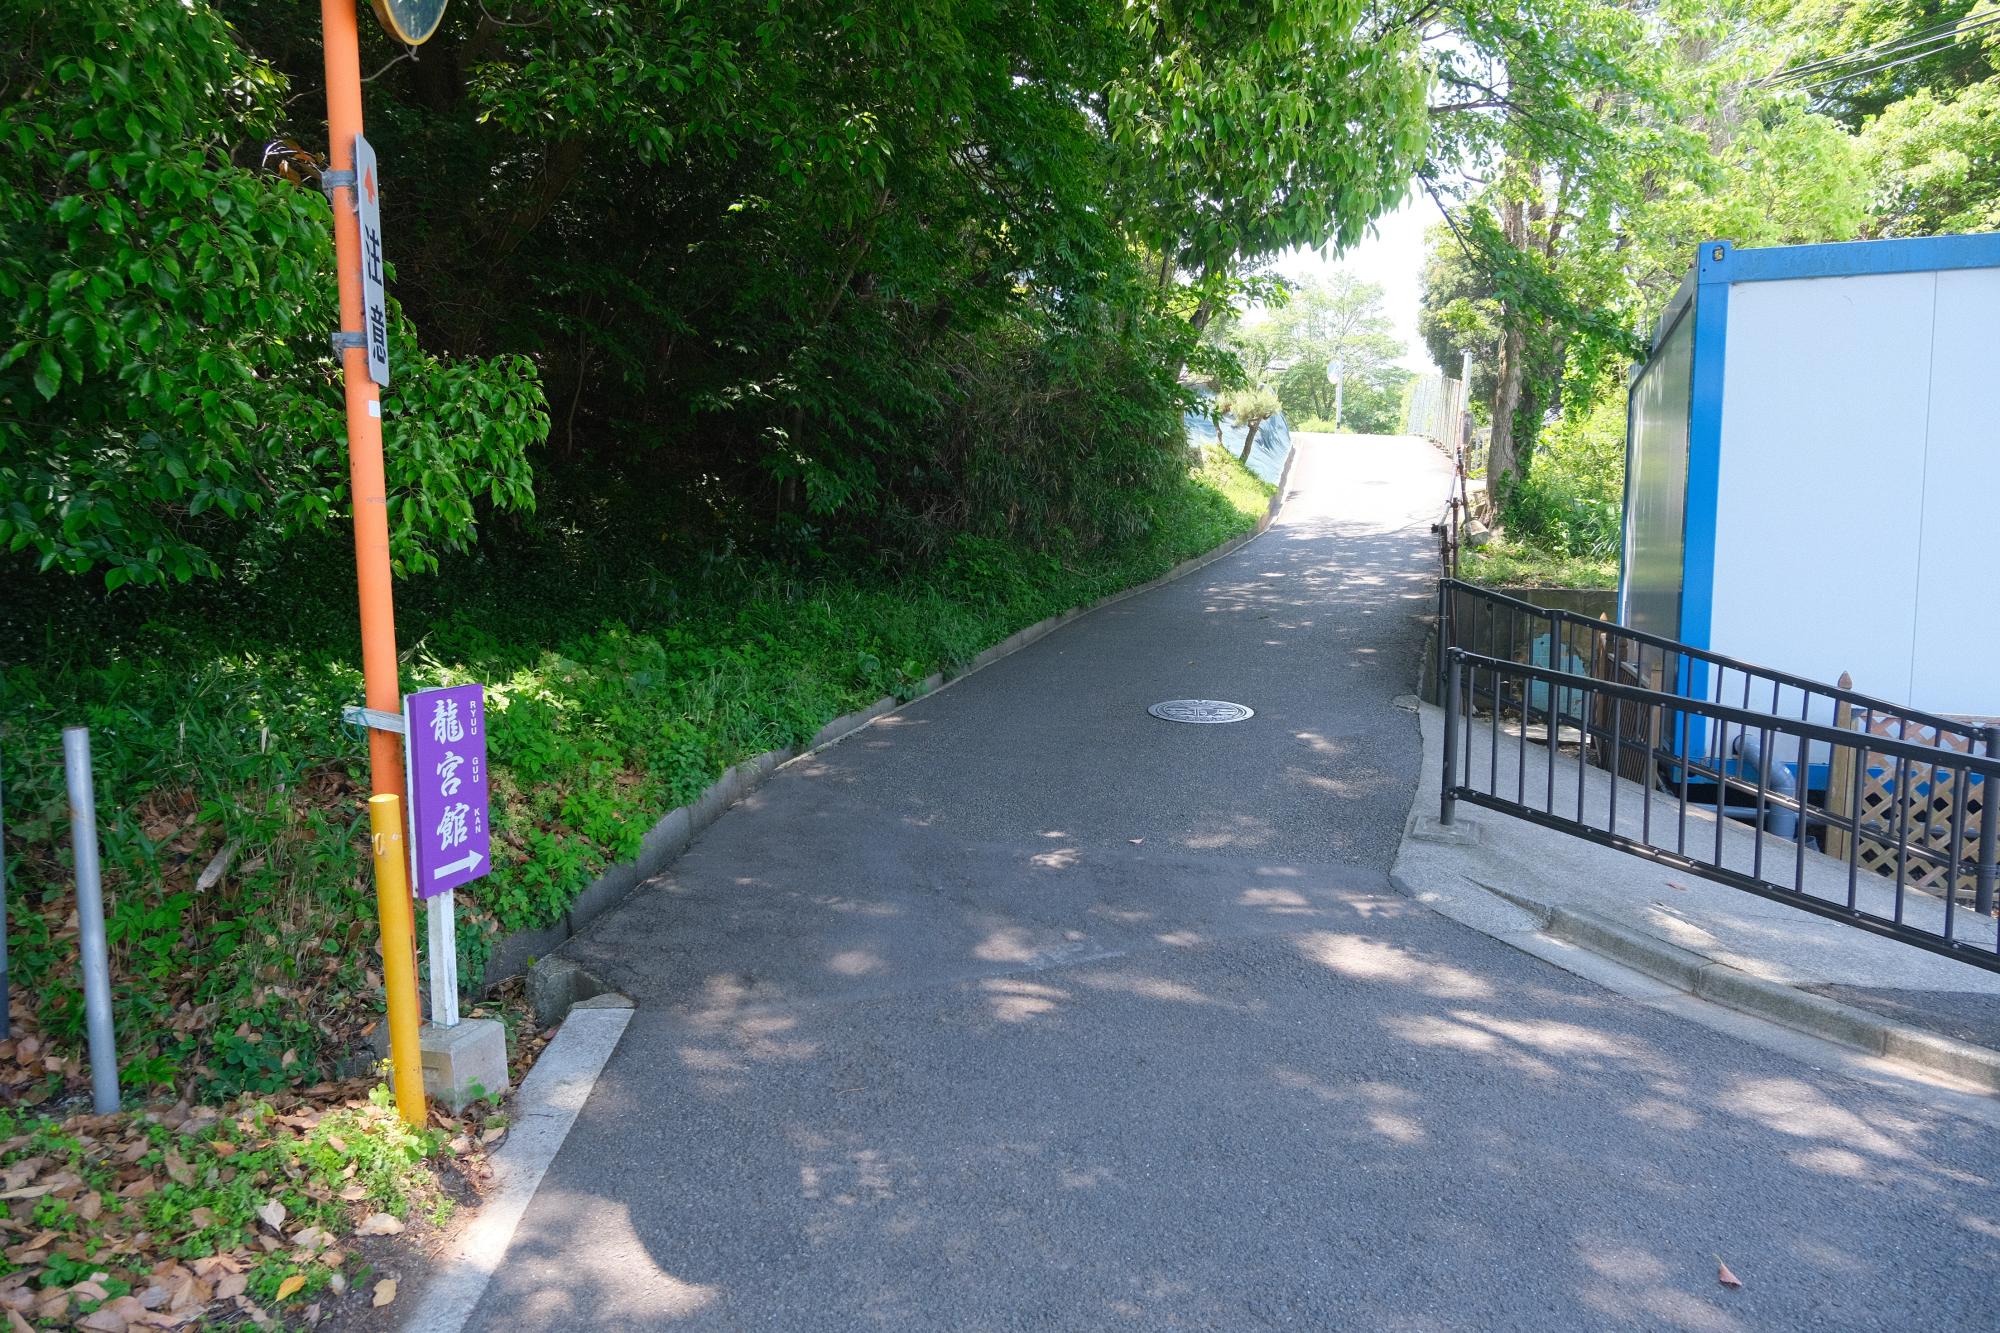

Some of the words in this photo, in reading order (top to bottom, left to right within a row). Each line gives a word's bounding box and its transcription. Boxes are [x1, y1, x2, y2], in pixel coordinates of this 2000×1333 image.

[365, 223, 387, 365] 注意
[430, 698, 470, 851] 龍宮館
[469, 700, 477, 735] RYUU
